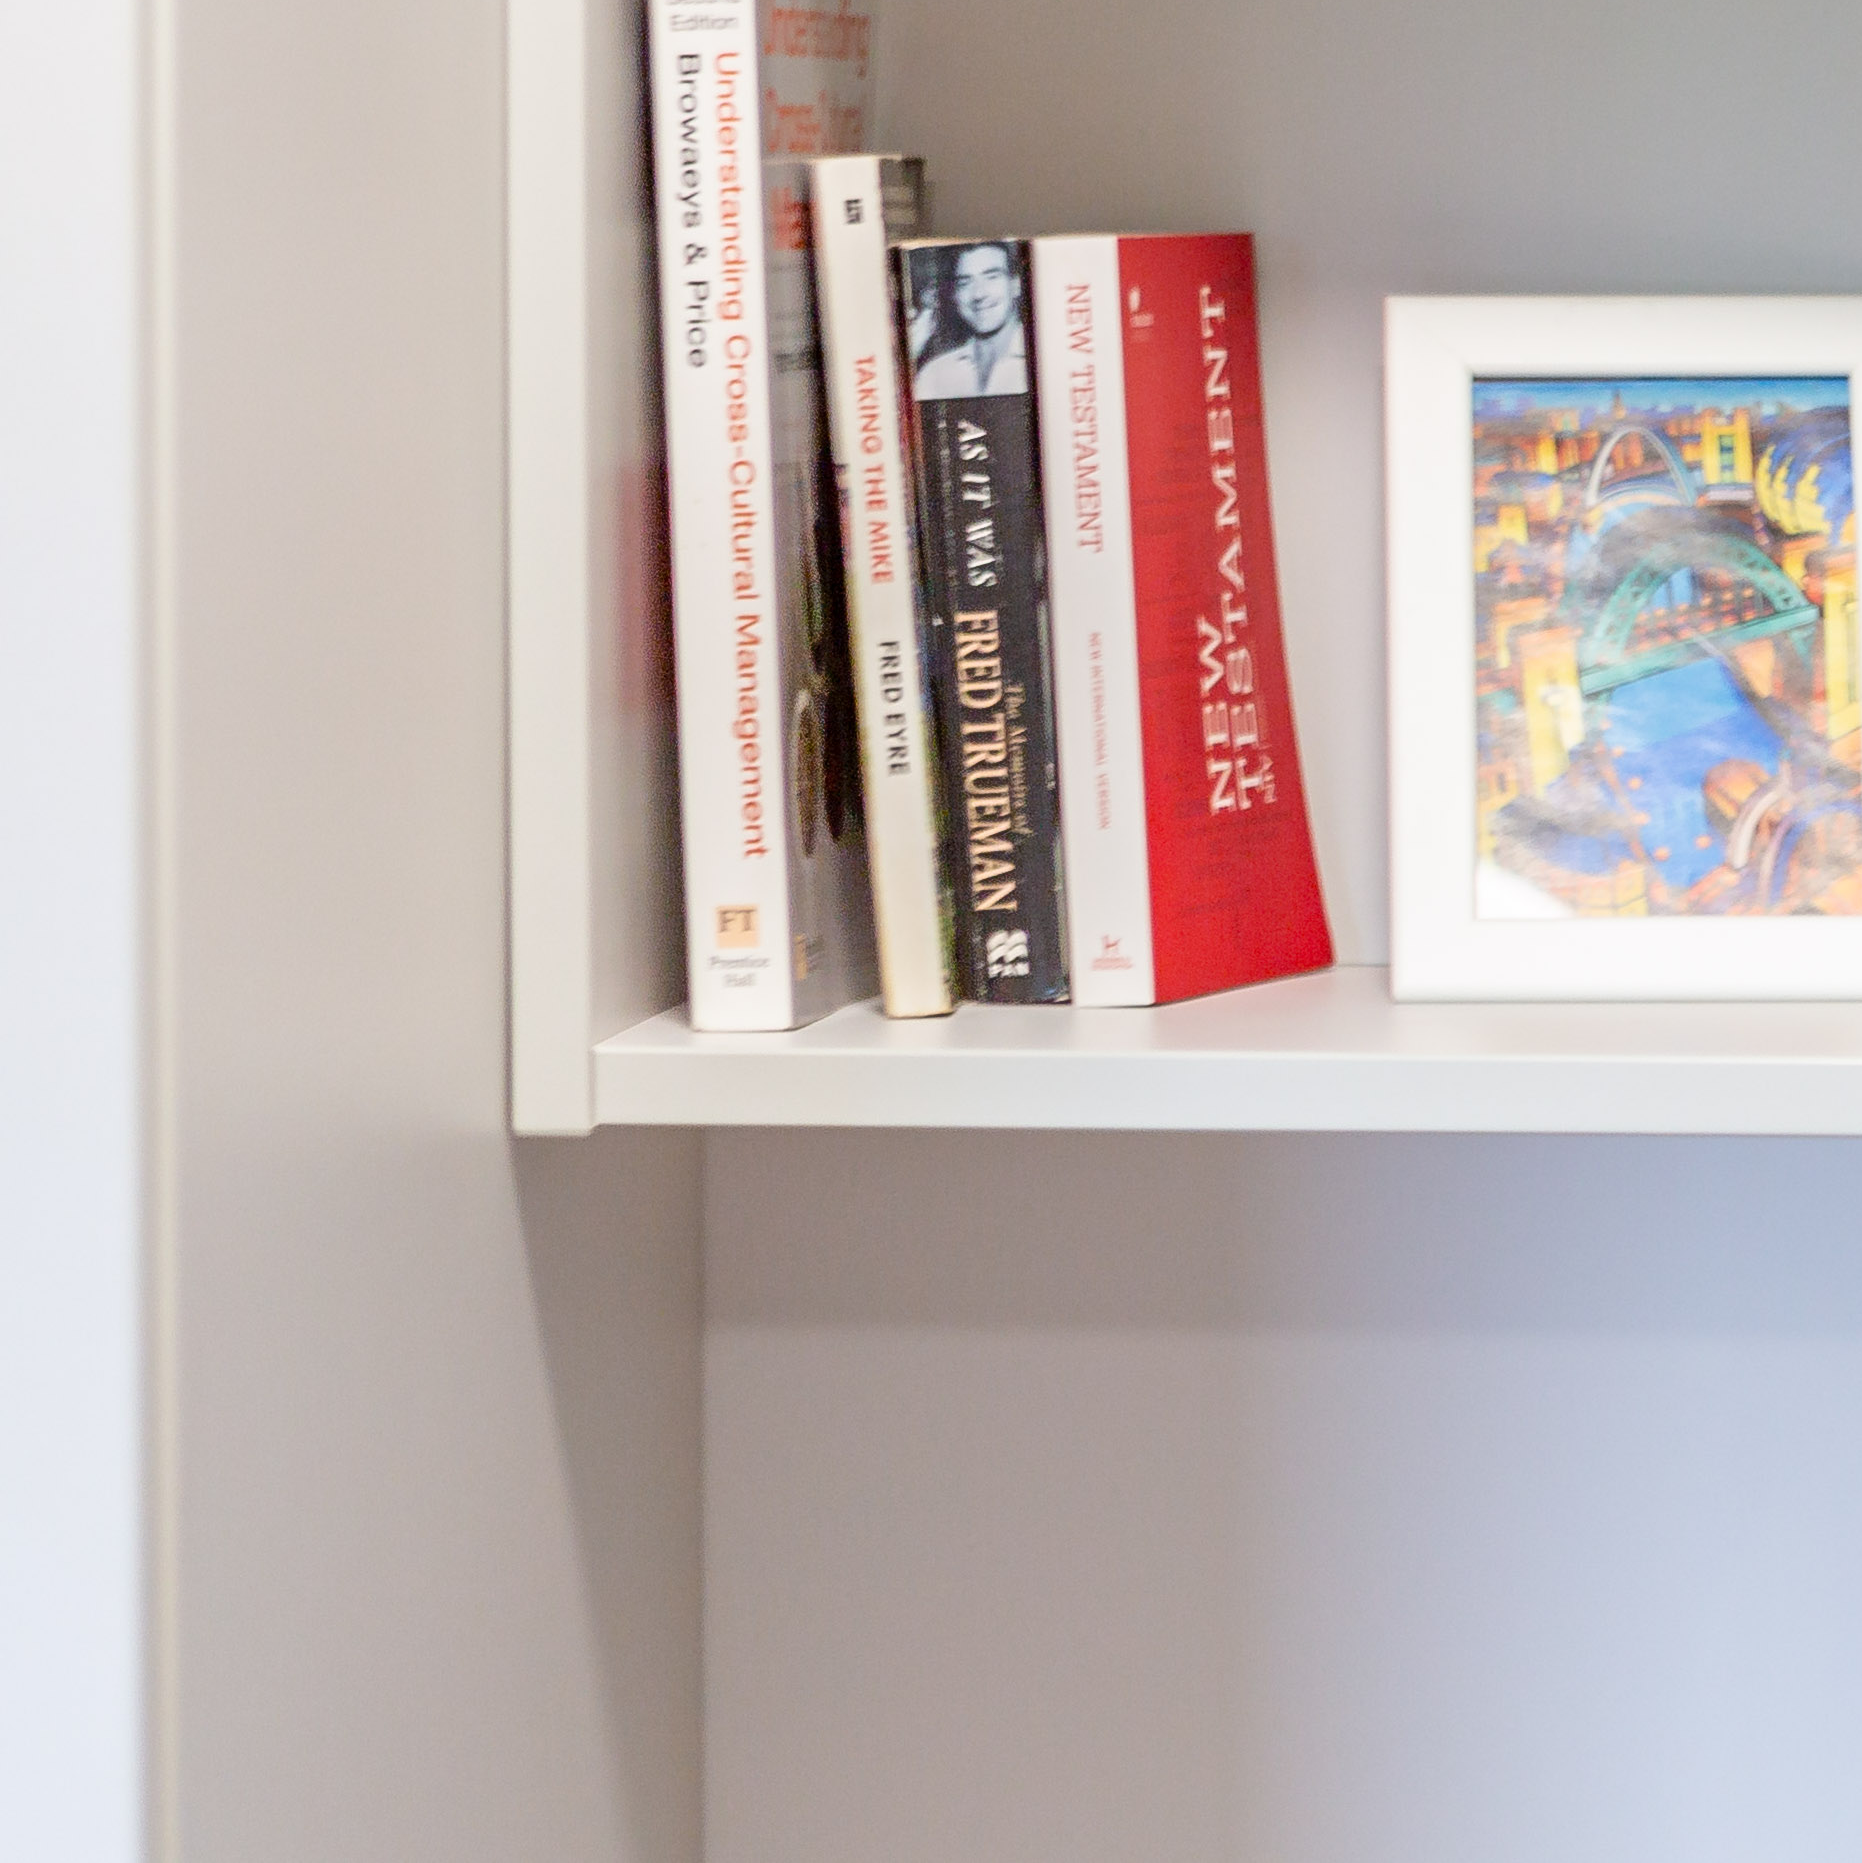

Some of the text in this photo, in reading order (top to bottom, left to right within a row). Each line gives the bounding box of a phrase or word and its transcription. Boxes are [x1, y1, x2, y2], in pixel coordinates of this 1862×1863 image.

[669, 14, 739, 32] Edition
[676, 53, 712, 368] Browaeys & Price
[714, 51, 770, 858] Understanding Cross-Cultural Management
[854, 355, 894, 584] TAKING THE MIKE
[957, 419, 998, 587] AS IT WAS
[1065, 283, 1105, 553] NEW TESTAMENT
[1199, 285, 1263, 811] TESTAMENT
[878, 641, 911, 776] FRED EYRE
[954, 610, 1019, 913] FRED TRUEMAN
[1197, 614, 1237, 816] NEW
[717, 908, 757, 932] FT
